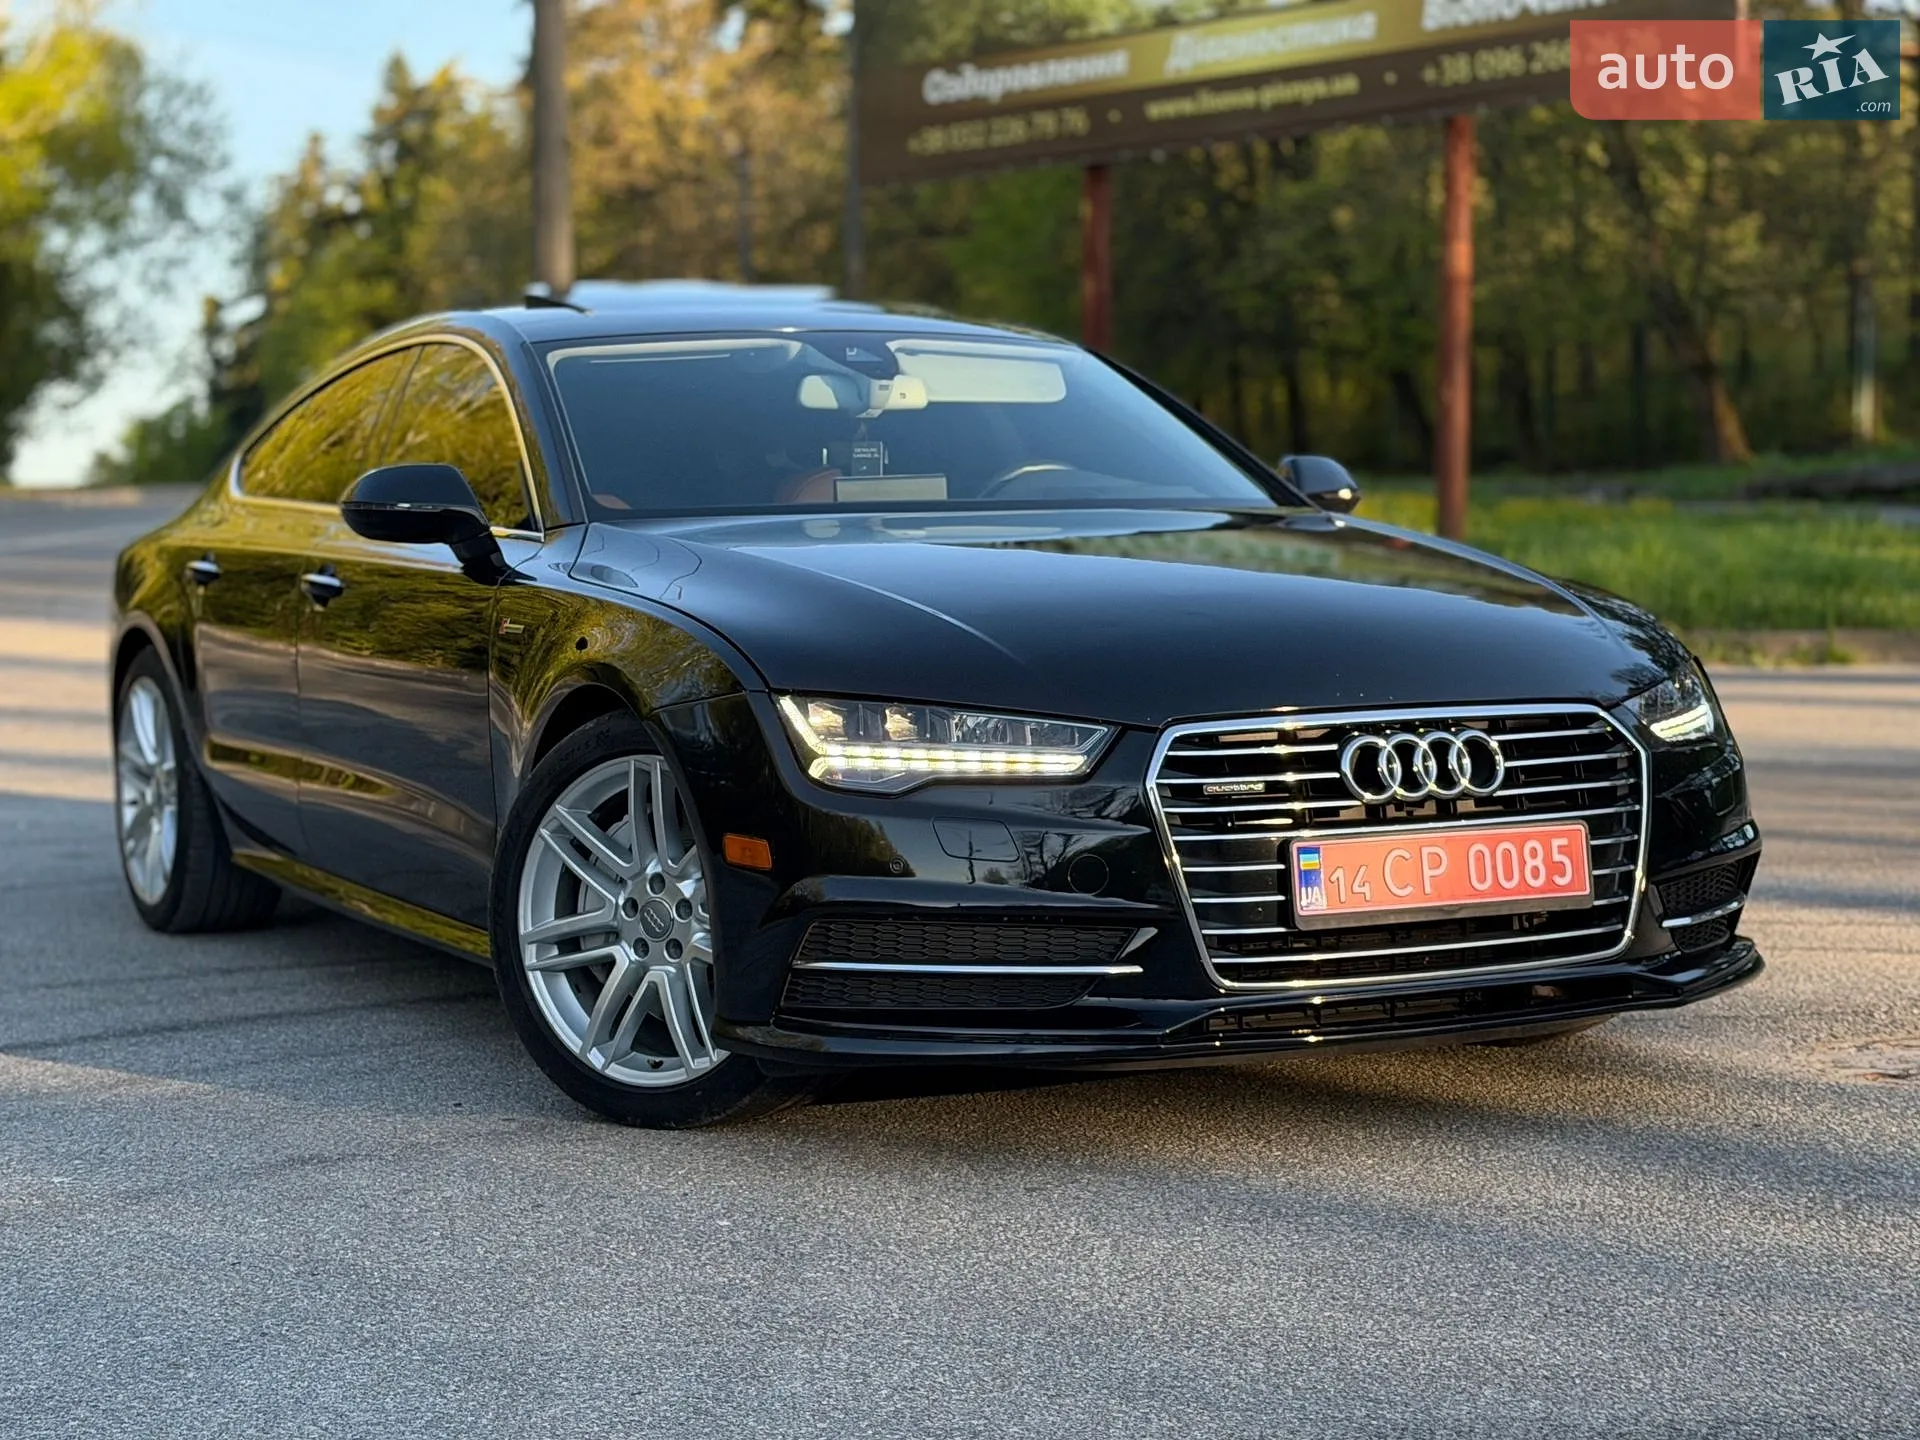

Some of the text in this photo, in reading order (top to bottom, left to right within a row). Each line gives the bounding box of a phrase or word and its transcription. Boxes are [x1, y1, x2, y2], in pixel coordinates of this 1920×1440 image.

[1421, 52, 1472, 88] +38
[1474, 44, 1527, 81] 096
[1329, 837, 1574, 904] 14 CP 0085
[1301, 886, 1323, 907] UA
